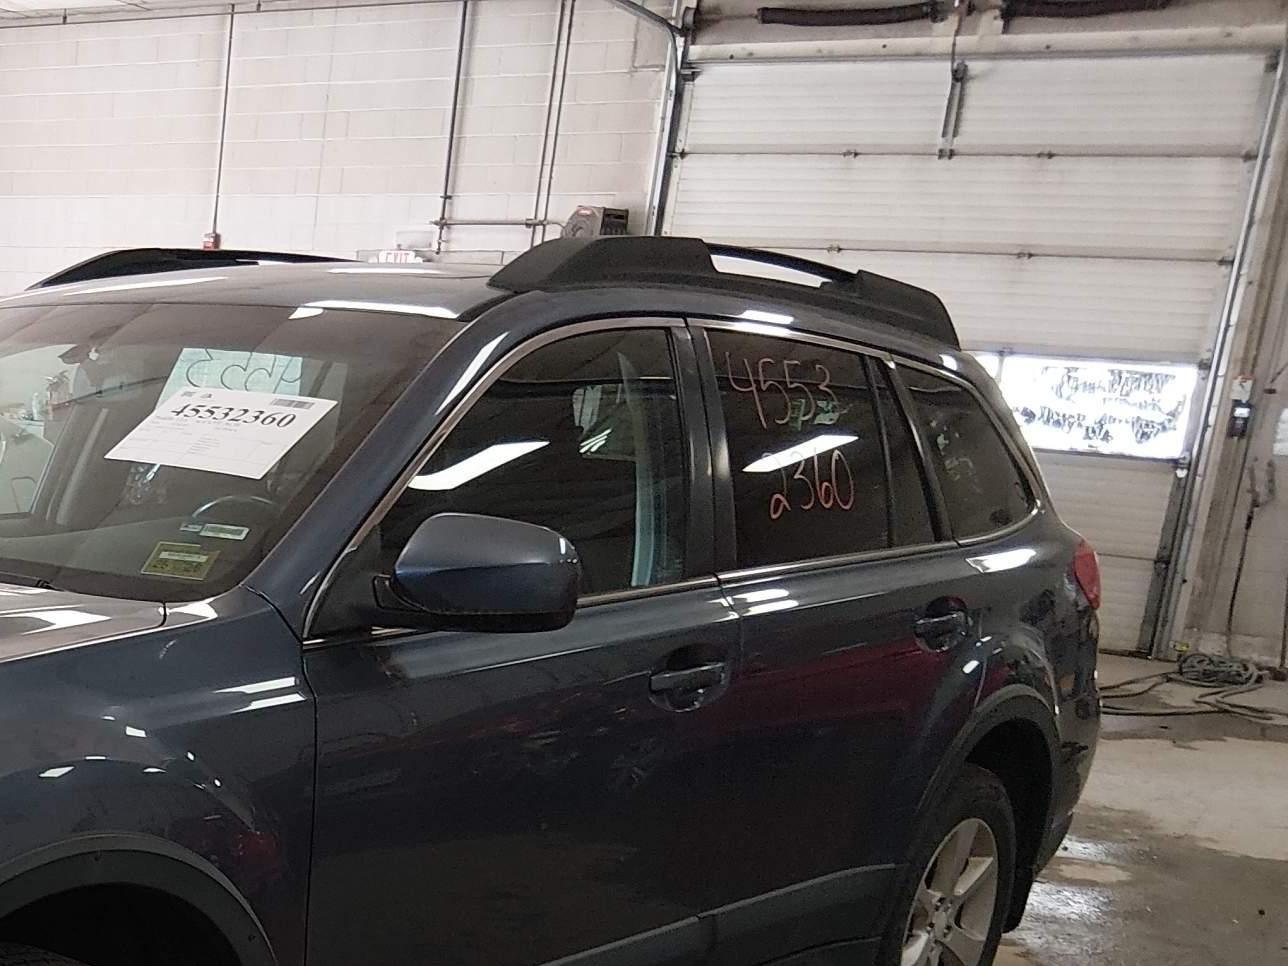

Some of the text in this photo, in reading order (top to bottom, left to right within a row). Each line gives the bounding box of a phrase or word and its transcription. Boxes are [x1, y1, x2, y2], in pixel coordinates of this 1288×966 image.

[170, 403, 297, 429] 45532360
[726, 351, 843, 430] 4553
[761, 448, 855, 520] 2360
